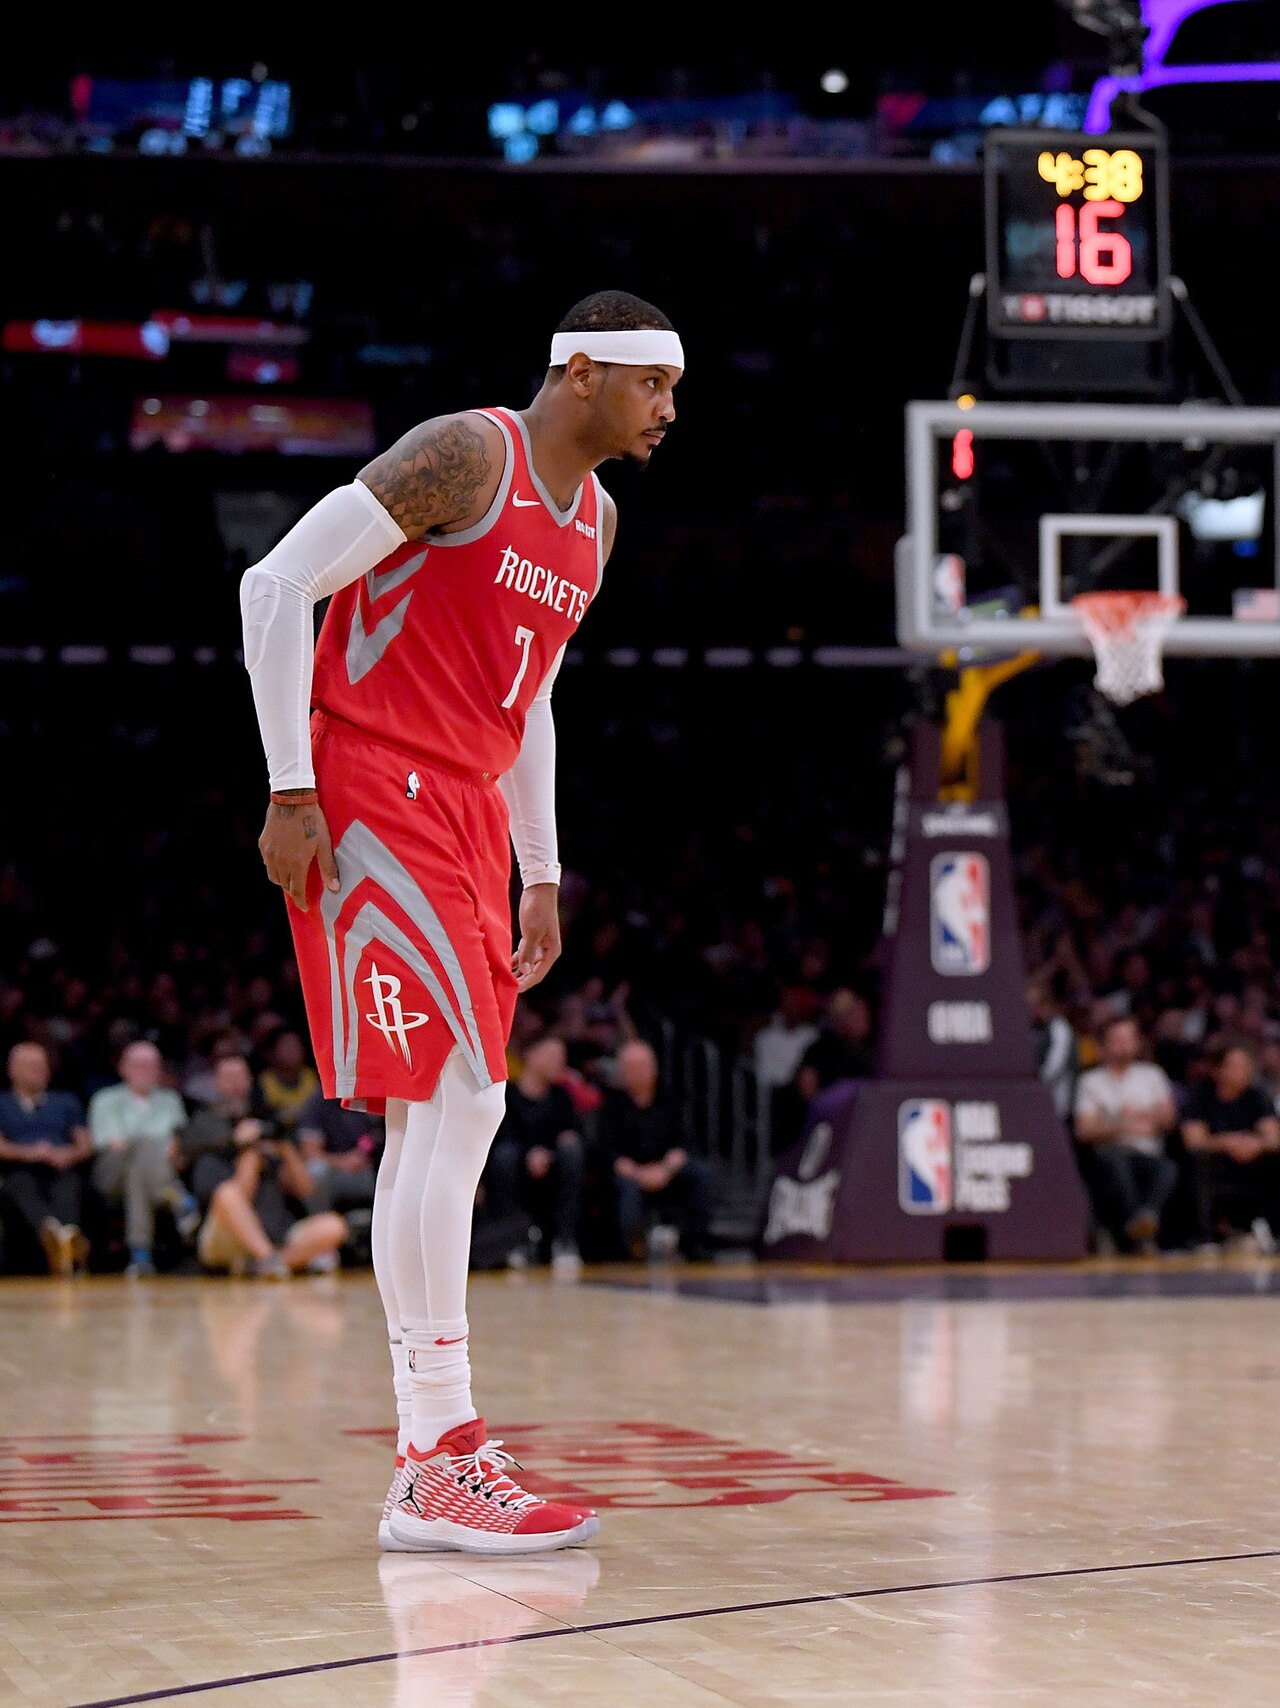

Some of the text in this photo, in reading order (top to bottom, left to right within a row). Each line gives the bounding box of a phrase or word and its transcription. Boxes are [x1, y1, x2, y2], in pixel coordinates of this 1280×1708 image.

[1038, 149, 1143, 202] 4:38
[1056, 200, 1132, 285] 16
[494, 545, 588, 622] ROCKETS
[501, 625, 535, 708] 7
